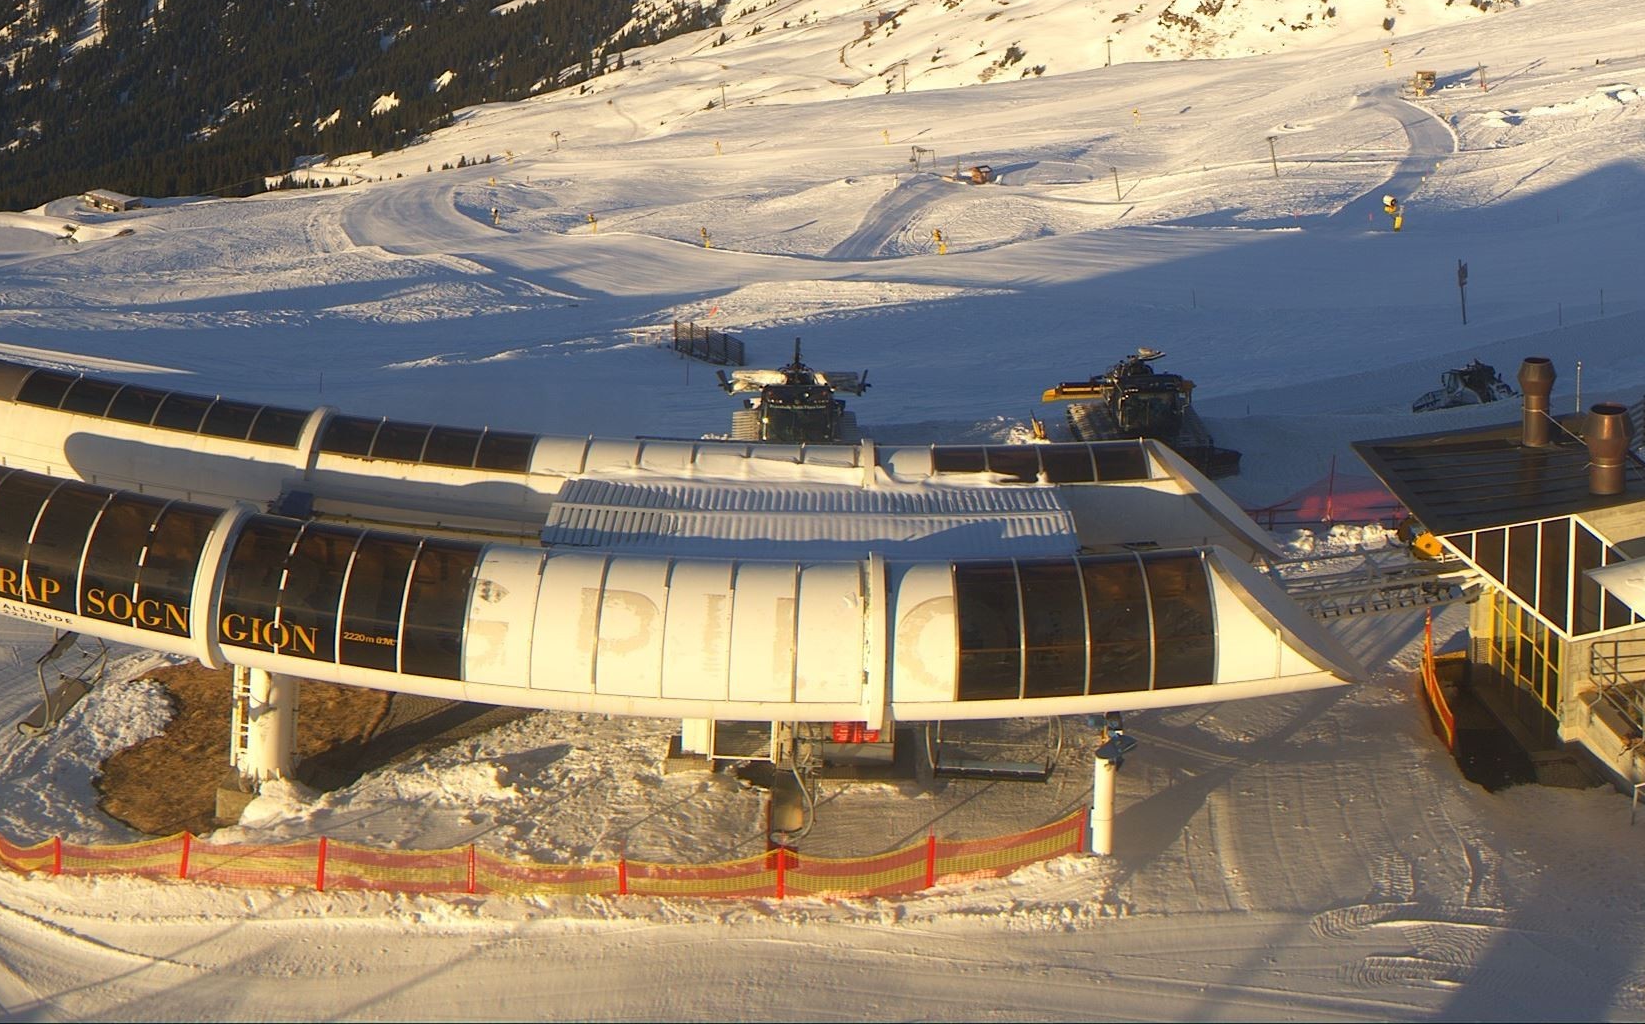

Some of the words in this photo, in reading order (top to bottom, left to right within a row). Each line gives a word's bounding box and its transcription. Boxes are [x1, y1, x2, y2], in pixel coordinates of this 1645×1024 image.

[3, 603, 73, 625] ALTITUDE
[86, 588, 190, 633] SOGN
[222, 613, 319, 654] GION
